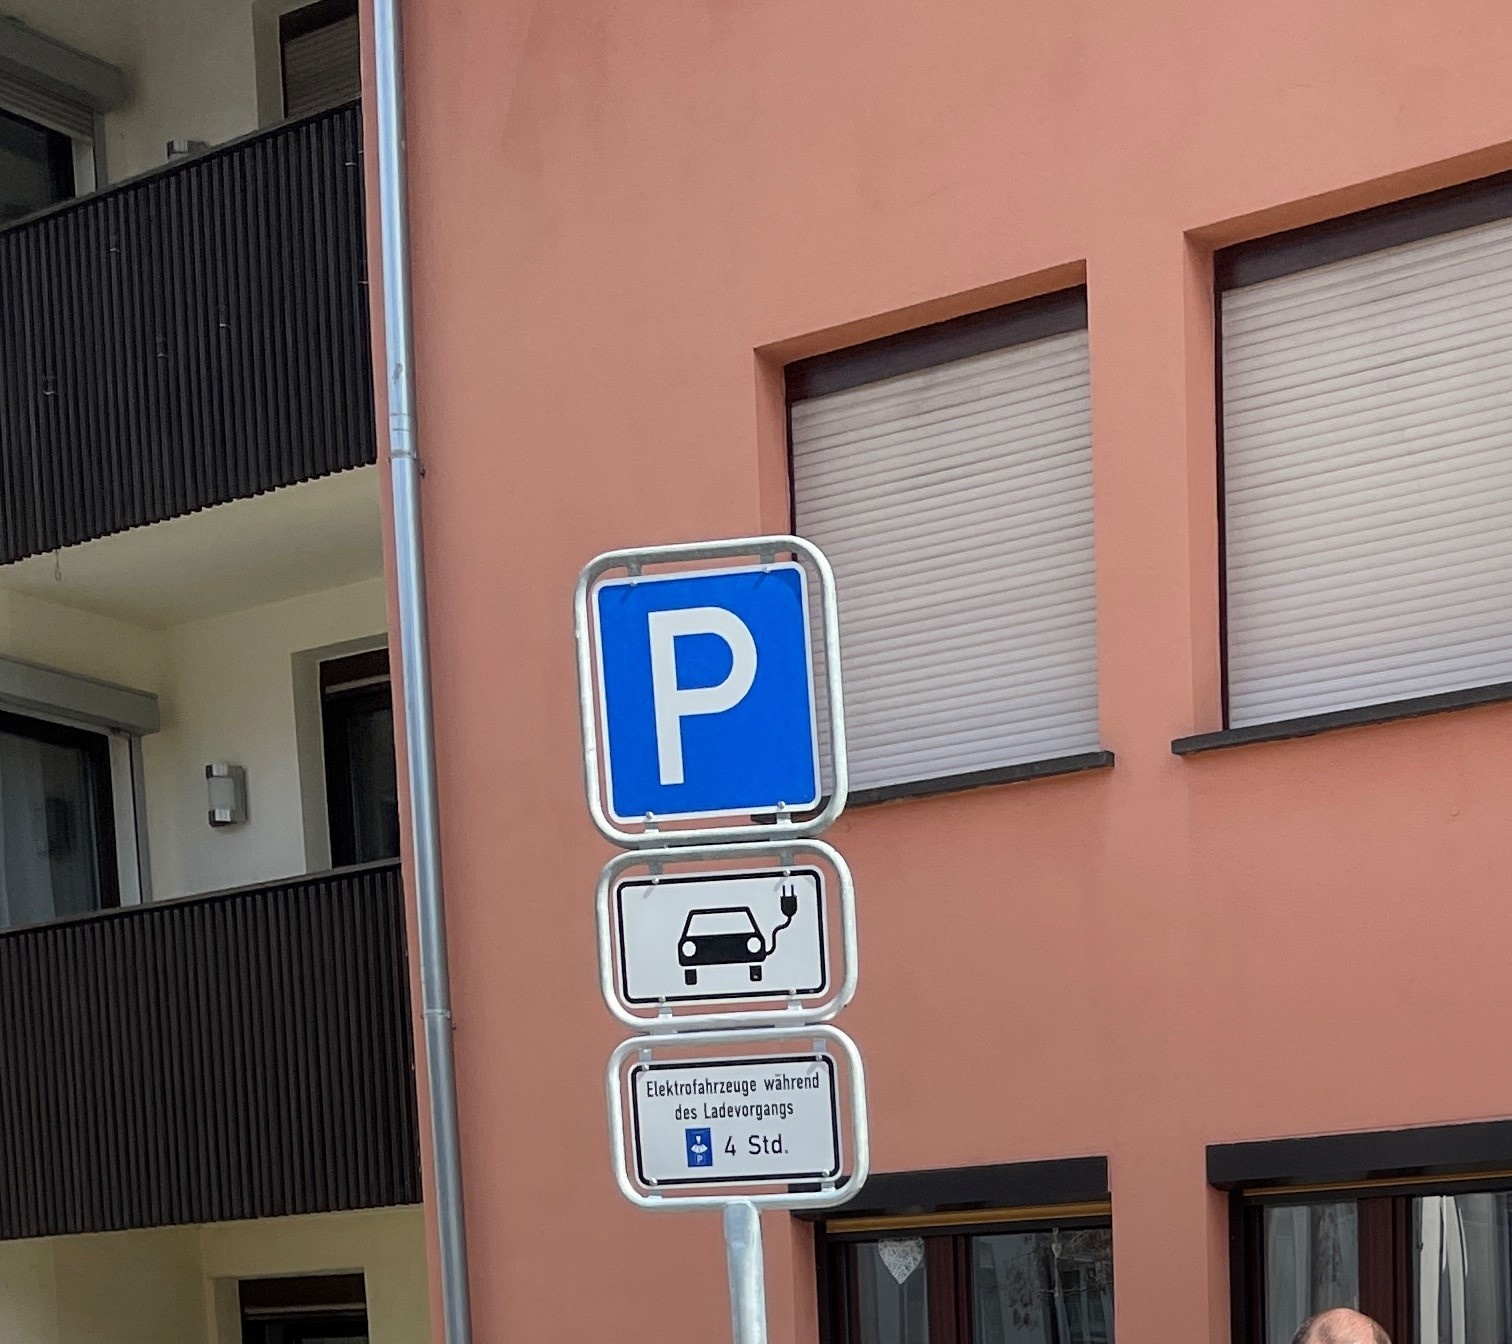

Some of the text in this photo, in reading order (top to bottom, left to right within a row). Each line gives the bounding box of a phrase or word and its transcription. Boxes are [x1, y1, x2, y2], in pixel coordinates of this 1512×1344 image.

[648, 606, 757, 785] P
[646, 1072, 820, 1098] Elektrofahrzeuge während
[675, 1101, 794, 1121] des Ladevorgangs
[724, 1133, 789, 1156] 4 Std.
